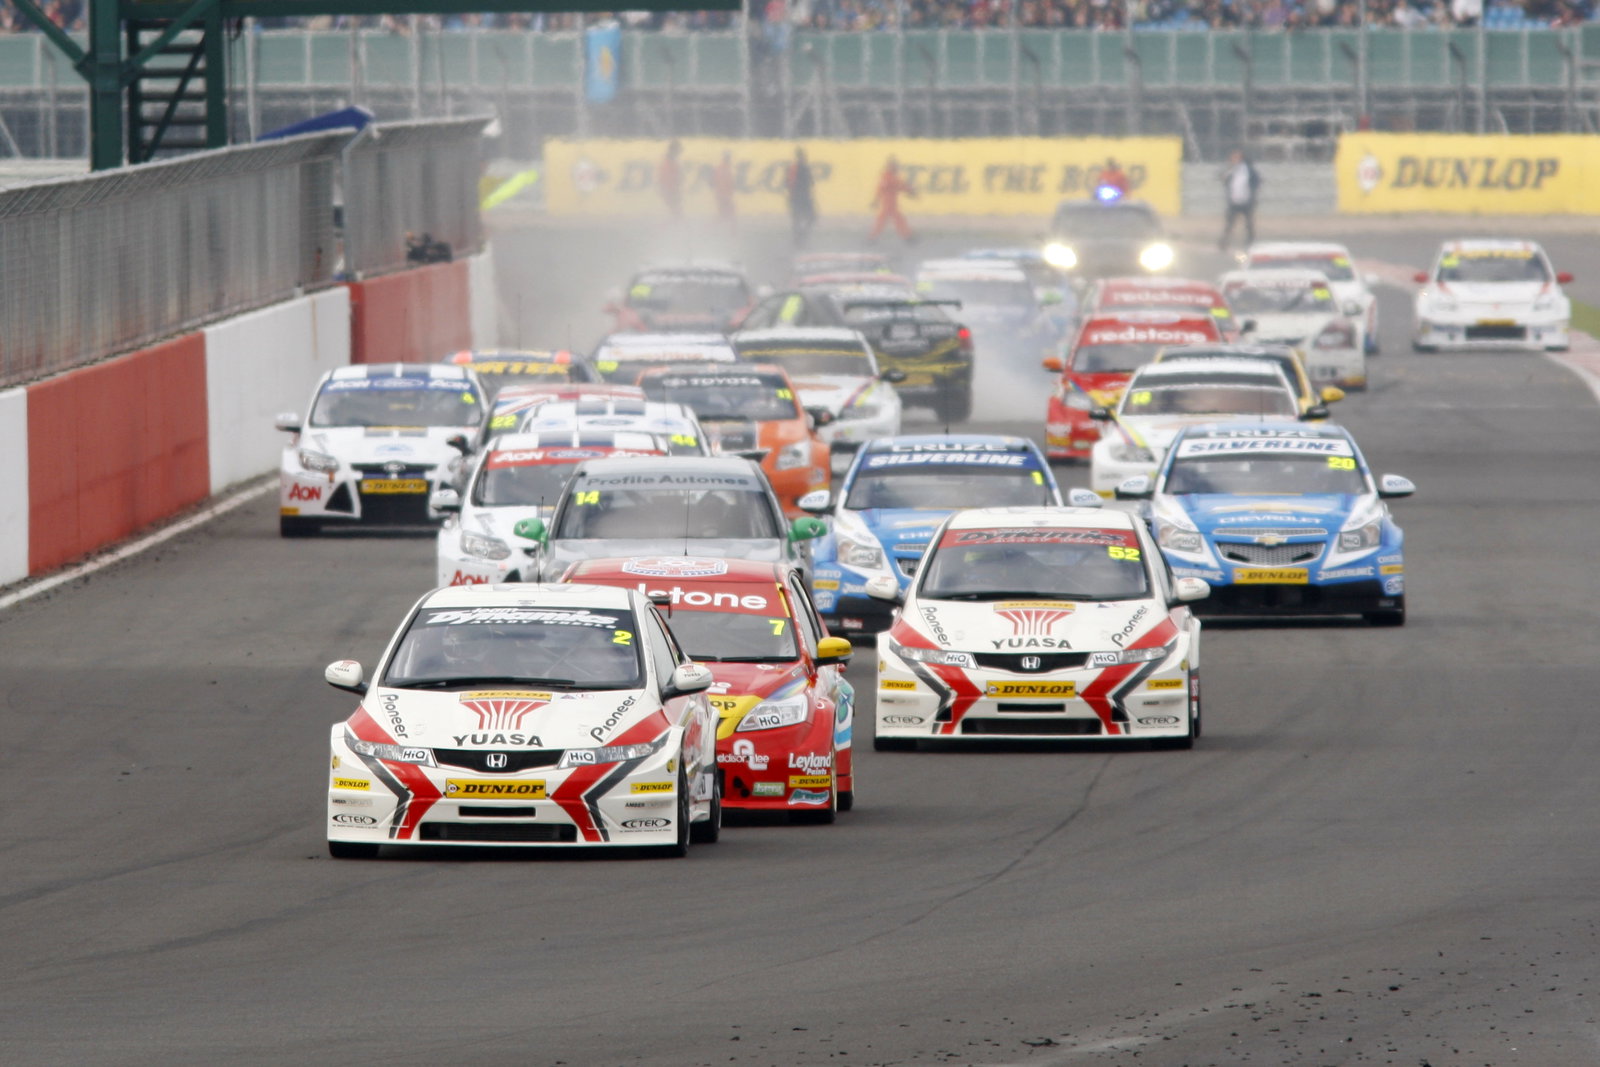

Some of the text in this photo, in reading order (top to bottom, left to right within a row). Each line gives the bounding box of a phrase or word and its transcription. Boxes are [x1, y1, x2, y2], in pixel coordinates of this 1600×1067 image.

[615, 160, 832, 194] DNLOP
[1058, 162, 1147, 194] ROD
[1391, 156, 1560, 191] DUNLOP
[1090, 326, 1207, 343] redstone
[327, 380, 370, 391] AON
[427, 379, 471, 390] AON
[690, 377, 762, 386] TOYOTA
[490, 415, 517, 429] 22
[1189, 440, 1341, 452] SILVERLINE
[494, 451, 544, 462] AON
[868, 453, 1027, 466] SILVERLINE
[1328, 457, 1356, 470] 20
[586, 475, 655, 486] Profile
[1030, 470, 1043, 486] 1
[289, 482, 322, 501] AON
[575, 490, 600, 505] 14
[1218, 515, 1323, 524] CHEVROLET
[958, 530, 1128, 545] Dynamics
[1108, 545, 1141, 562] 52
[1247, 571, 1308, 581] DUNLOP
[426, 610, 620, 625] Dynamics
[768, 619, 785, 636] 7
[920, 606, 951, 647] Pioneer
[1111, 605, 1149, 647] Pioneer
[613, 630, 633, 646] 2
[991, 638, 1073, 650] YUASA
[945, 654, 967, 663] HiQ
[1095, 654, 1116, 663] HiQ
[1001, 685, 1074, 694] DUNLOP
[380, 694, 409, 739] Pioneer
[590, 695, 637, 743] Pioneer
[760, 715, 780, 727] HiQ
[453, 733, 544, 747] YUASA
[403, 750, 426, 760] HiQ
[570, 751, 594, 761] HiQ
[788, 751, 832, 772] Leyland
[806, 767, 827, 776] Paints
[337, 780, 370, 788] DUNLOP
[462, 784, 546, 794] DUNLOP
[640, 783, 673, 791] DUNLOP
